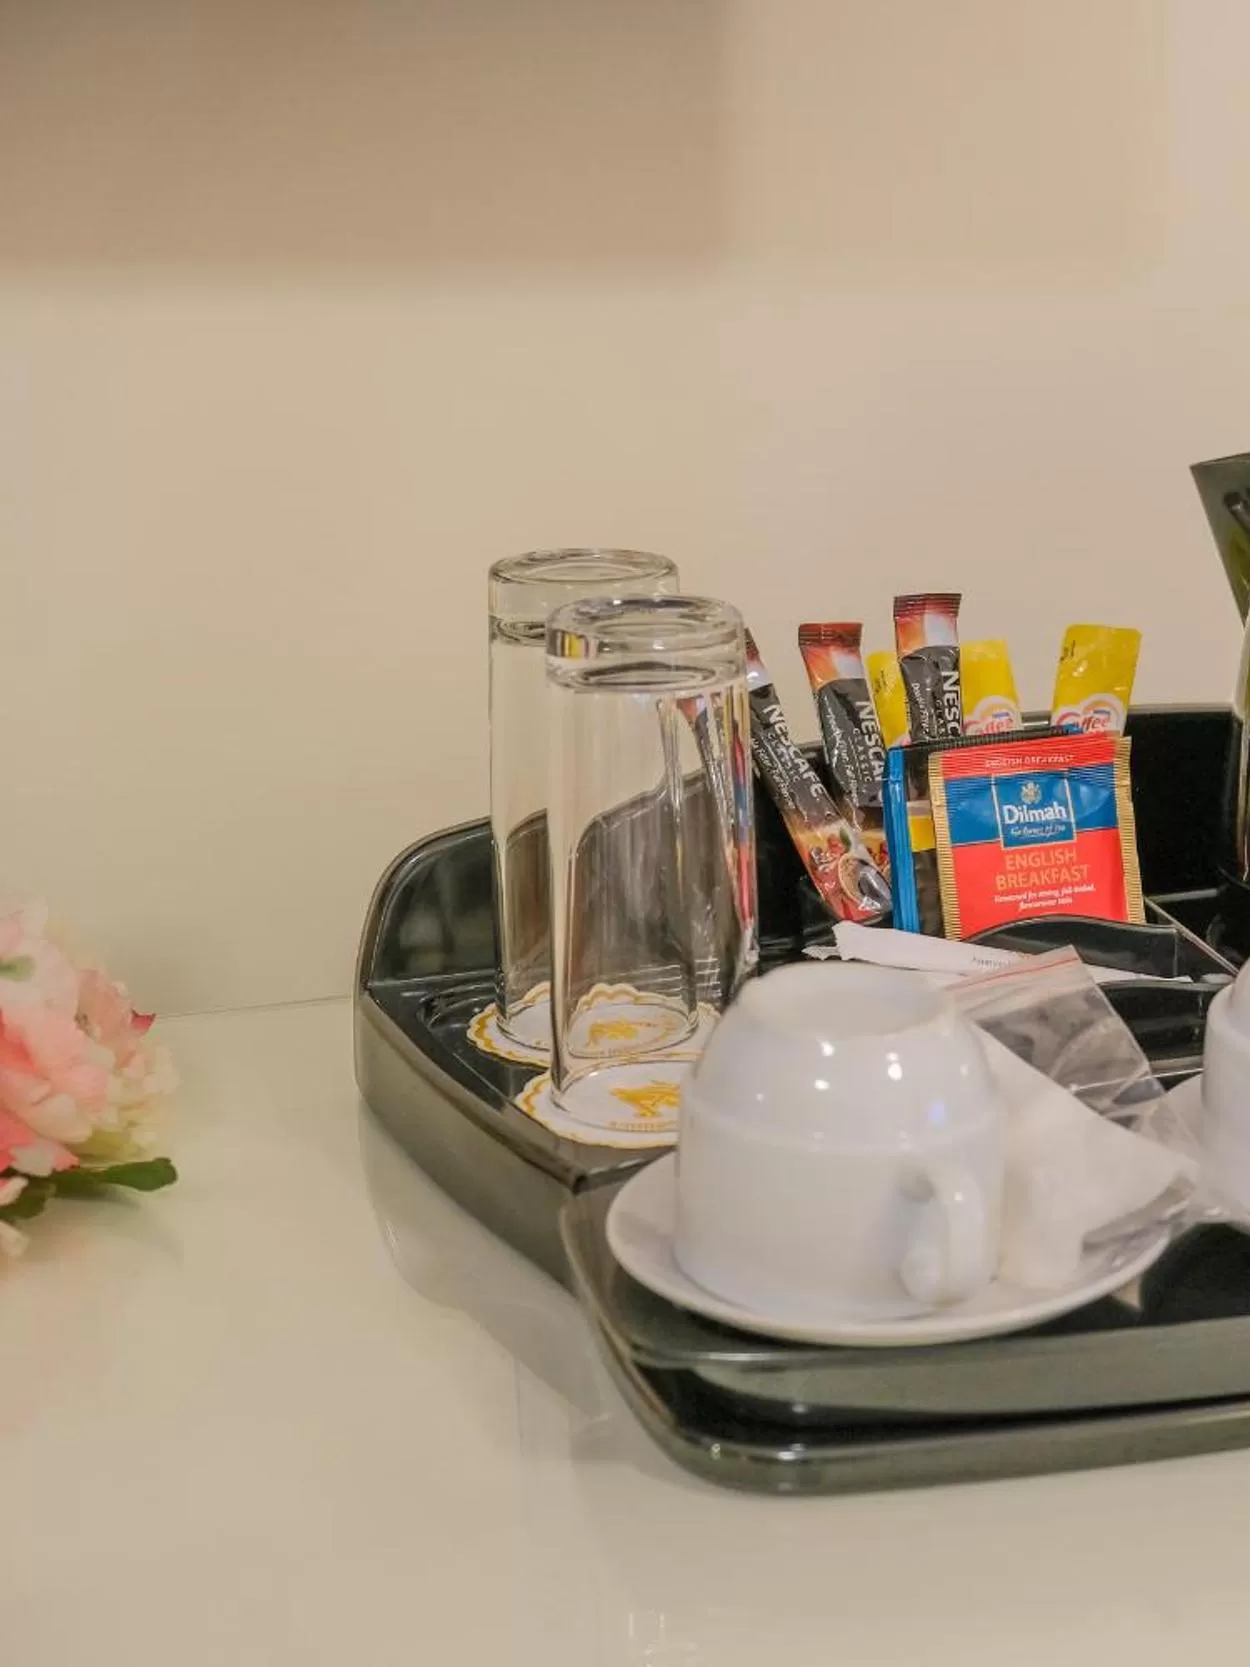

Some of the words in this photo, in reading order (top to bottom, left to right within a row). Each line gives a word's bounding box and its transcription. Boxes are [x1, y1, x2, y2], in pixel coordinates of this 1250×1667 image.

[1003, 801, 1067, 824] Dilmah
[1005, 847, 1077, 870] ENGLISH
[995, 864, 1090, 891] BREAKFAST
